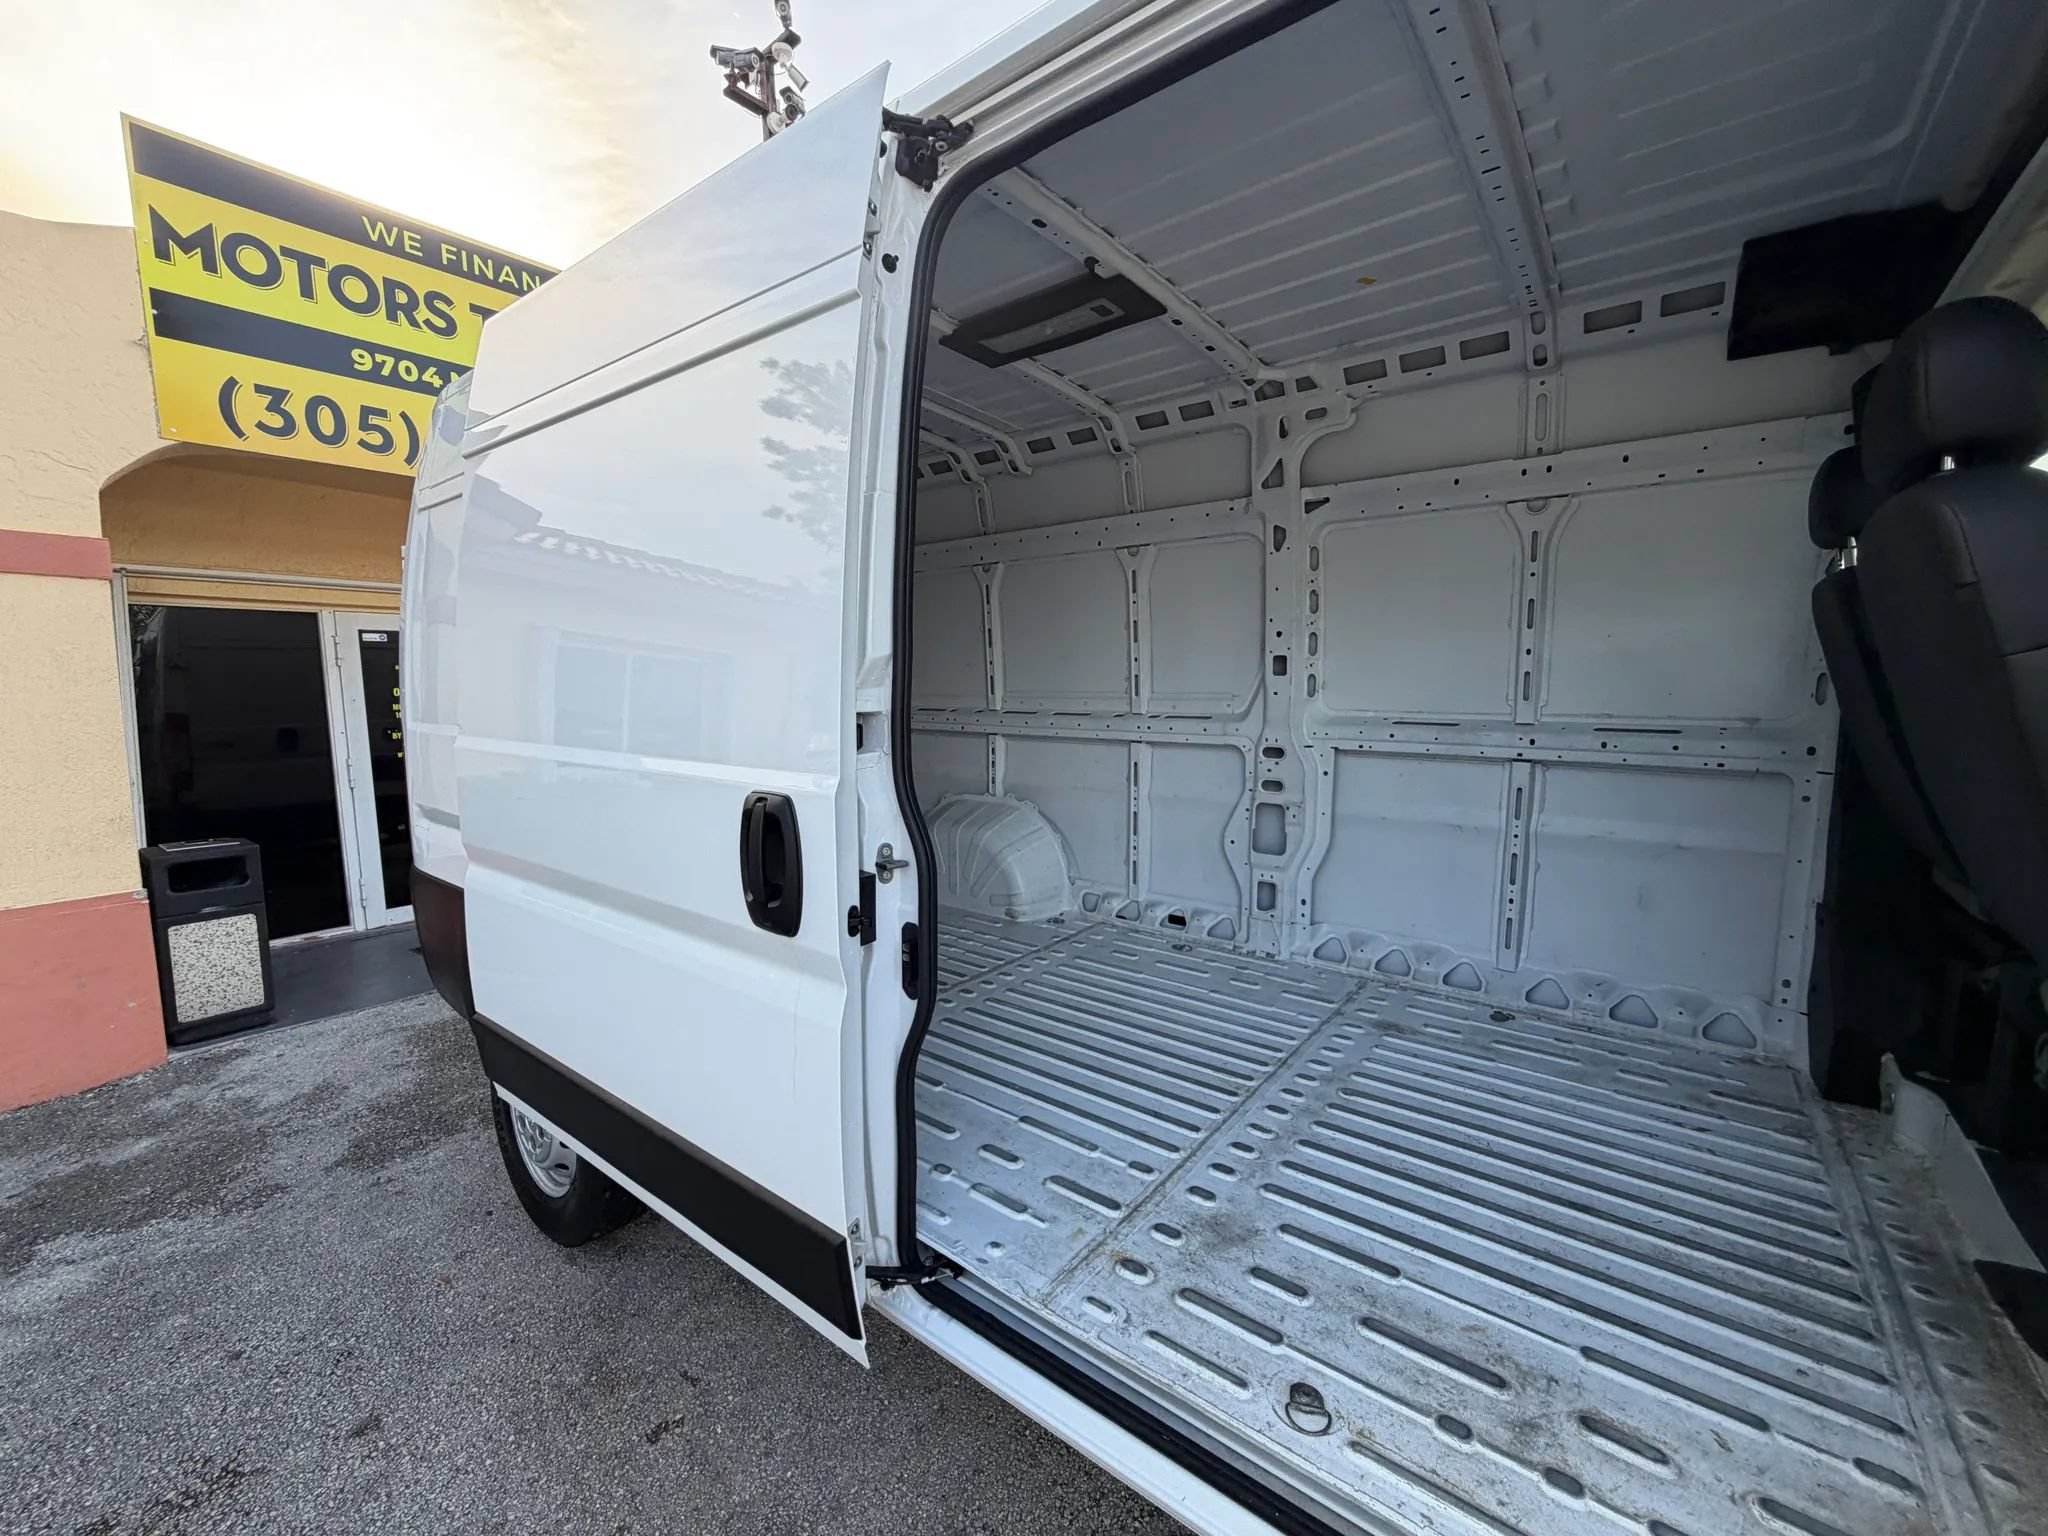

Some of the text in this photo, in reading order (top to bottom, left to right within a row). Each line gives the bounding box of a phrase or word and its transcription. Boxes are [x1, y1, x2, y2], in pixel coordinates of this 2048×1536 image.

[148, 203, 459, 340] MOTORS
[361, 215, 541, 292] WE FINAN
[351, 348, 443, 388] 9704
[218, 375, 421, 470] (305)
